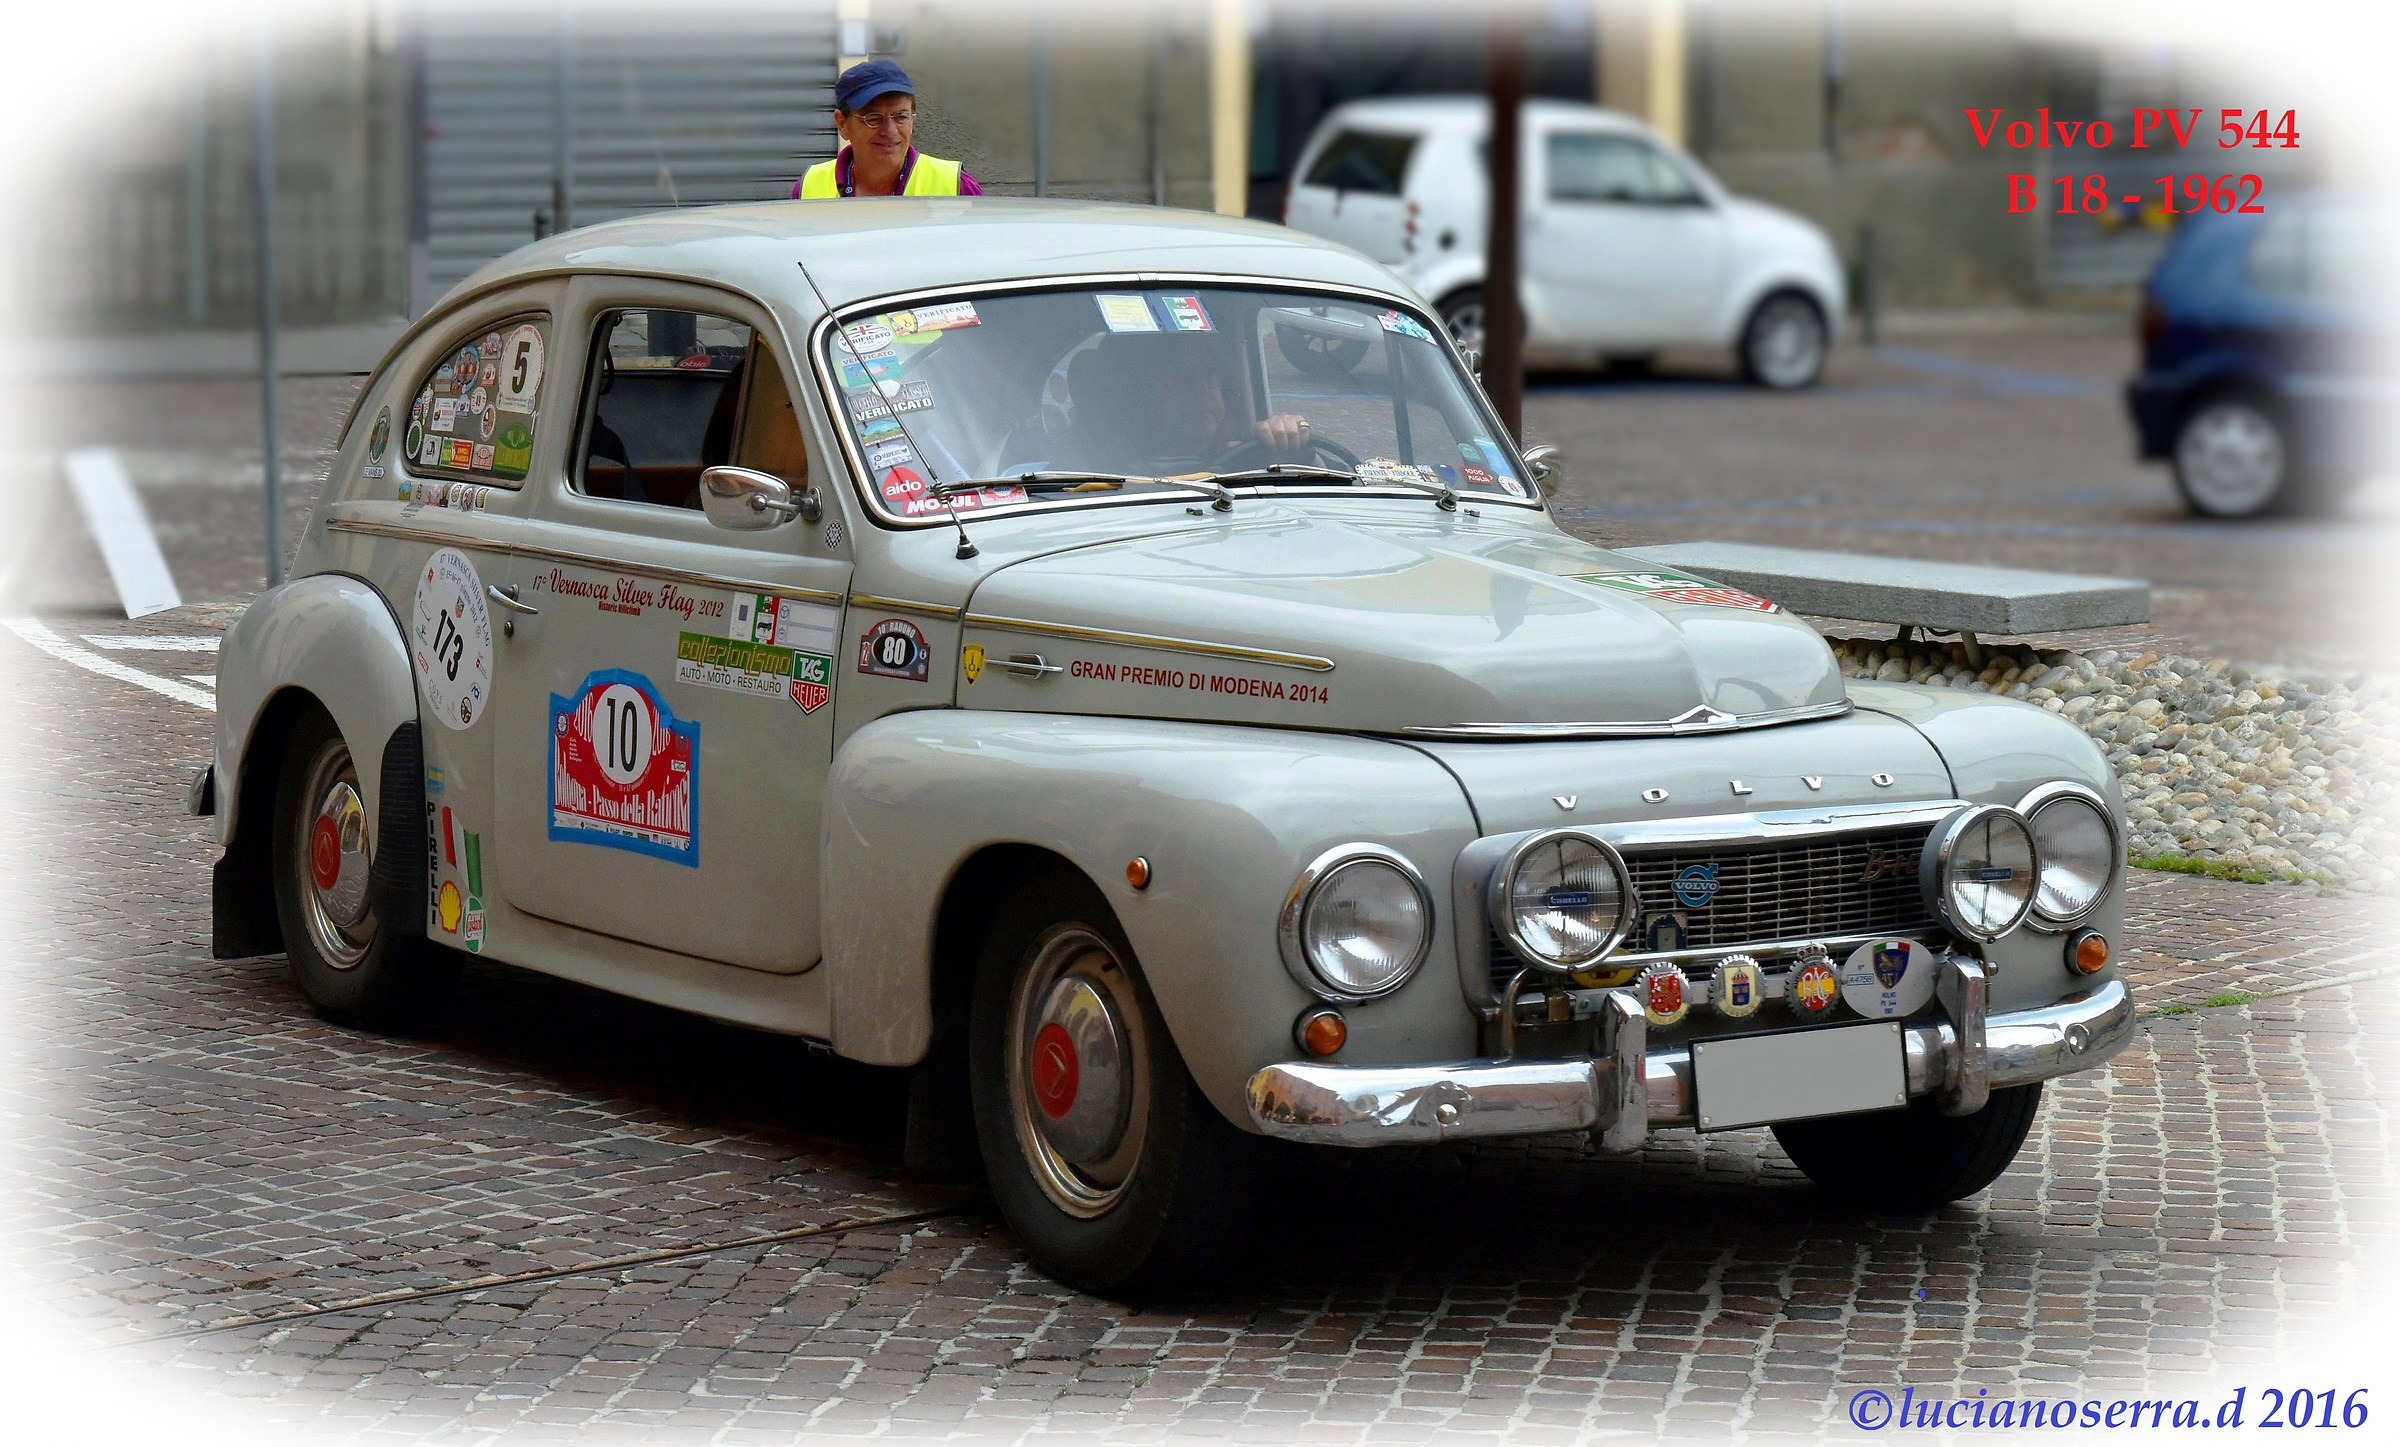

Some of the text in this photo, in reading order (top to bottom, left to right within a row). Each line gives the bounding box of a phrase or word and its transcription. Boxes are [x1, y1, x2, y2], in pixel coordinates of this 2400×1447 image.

[916, 304, 972, 319] VERIFICATO
[841, 331, 891, 347] VRIFICATO
[511, 341, 531, 393] 5
[842, 351, 894, 365] VEFICATO
[855, 397, 932, 422] VERIICATO
[886, 479, 922, 496] aido
[907, 495, 975, 514] MOUL
[550, 567, 609, 600] Vernasca
[612, 577, 654, 608] Silver
[657, 583, 695, 621] Flag
[698, 600, 724, 618] 2012
[889, 622, 916, 638] RADUNO
[433, 608, 464, 682] 173
[678, 636, 791, 680] collezionismo
[882, 636, 907, 665] 80
[680, 667, 701, 680] AUTO
[707, 671, 731, 685] MOTO
[737, 676, 782, 694] RESTAURO
[799, 657, 825, 682] TAG
[1070, 661, 1329, 704] GRAN PREMIO DI MODENA 2014
[793, 683, 826, 709] HEUER
[607, 697, 638, 772] 10
[592, 784, 619, 819] Passo
[621, 793, 645, 824] della
[1552, 773, 1895, 811] VOLVO
[426, 801, 438, 925] PIRELLI
[1674, 881, 1718, 891] VOLVO
